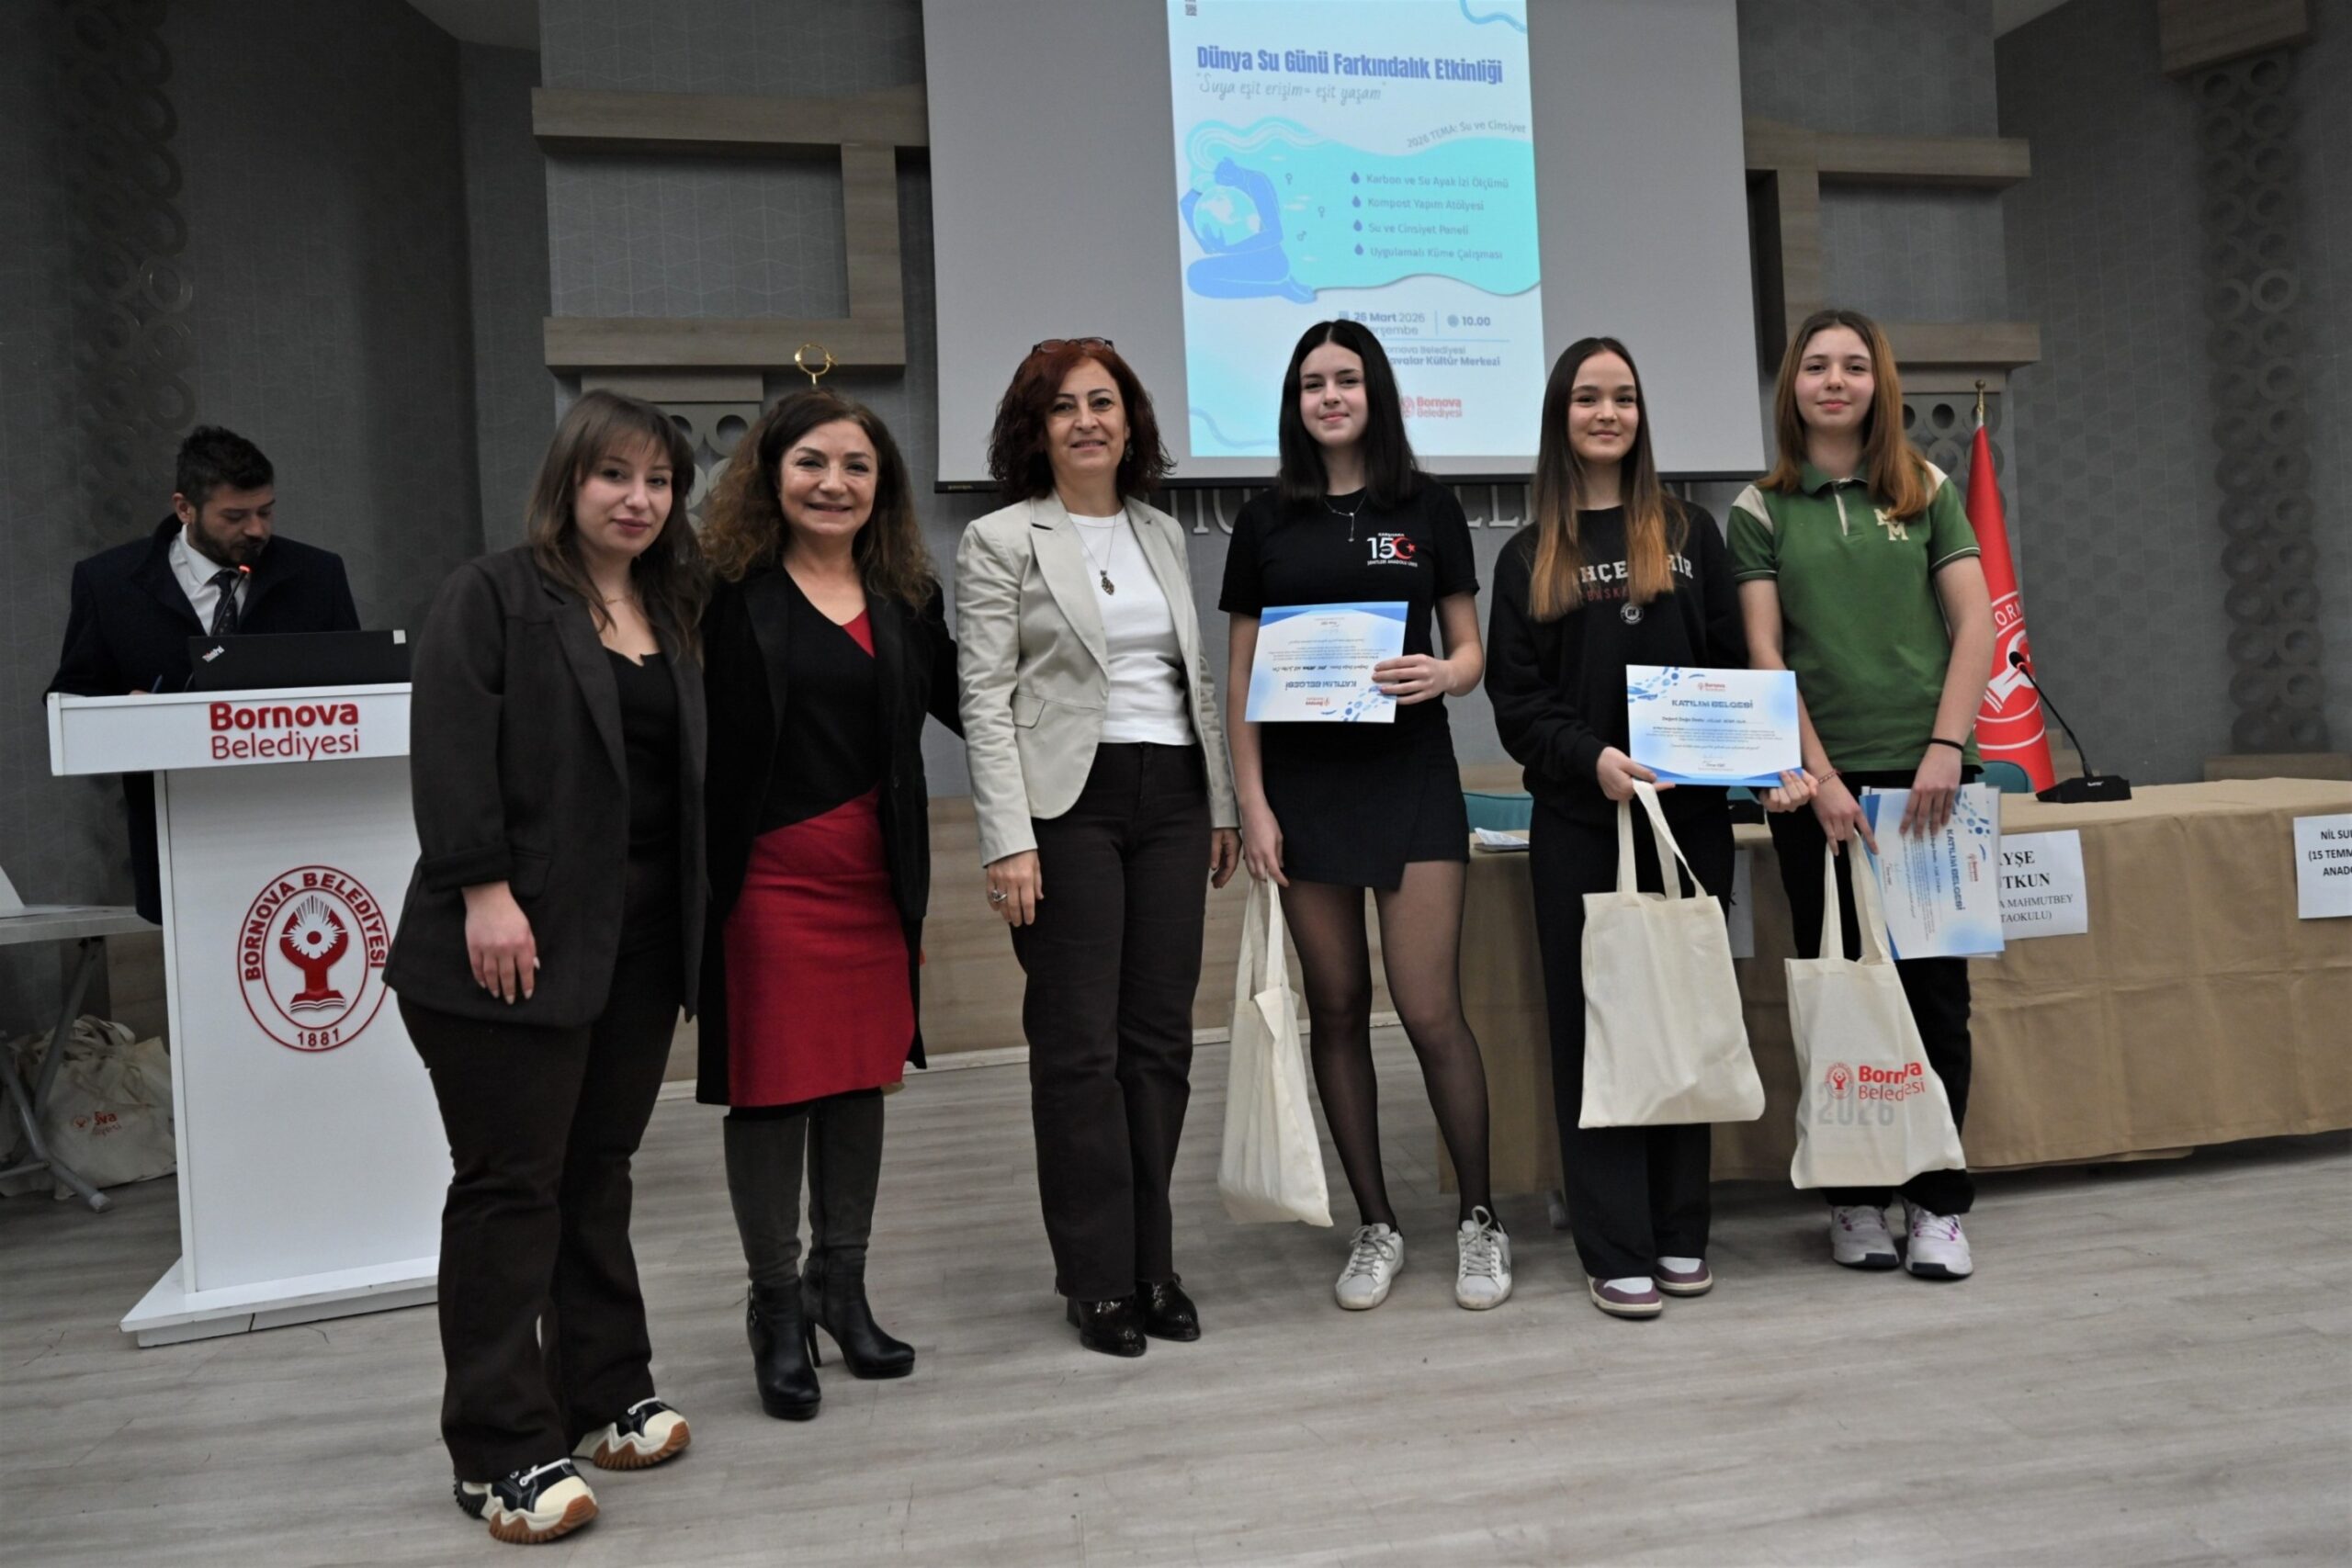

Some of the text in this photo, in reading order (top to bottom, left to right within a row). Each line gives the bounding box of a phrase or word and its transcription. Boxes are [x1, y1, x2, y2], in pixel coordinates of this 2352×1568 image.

[1197, 45, 1503, 85] Dünya Su Günü Farkındalık Etkinliği
[1459, 121, 1473, 132] Su
[1475, 121, 1486, 130] ve
[1487, 119, 1526, 134] Cinsiyet
[1366, 174, 1402, 186] Karbon
[1404, 177, 1416, 186] ve
[1418, 175, 1430, 186] Su
[1433, 176, 1456, 187] Ayak
[1472, 175, 1510, 190] Ölçümü
[1368, 197, 1485, 212] Kompost Yapım Atölyesi
[1368, 222, 1469, 236] Su ve Cinsiyet Paneli
[1370, 247, 1503, 262] Uygulamalı Küme Çalışması
[1369, 312, 1397, 322] Mart
[1398, 312, 1426, 323] 2026
[1462, 316, 1491, 326] 10.00
[1385, 345, 1419, 355] ornova
[1425, 355, 1458, 366] Kültür
[1460, 355, 1501, 367] Merkezi
[1416, 396, 1462, 408] Bornova
[1416, 407, 1463, 420] Belediyesi
[209, 702, 359, 731] Bornova
[210, 728, 359, 761] Belediyesi
[2321, 829, 2335, 840] NİL
[1999, 851, 2035, 867] YŞE
[2308, 850, 2323, 862] (15
[2323, 865, 2352, 876] ANAD
[2007, 894, 2074, 908] MAHMUTBEY
[243, 880, 296, 982] BORNOVA
[297, 1028, 340, 1047] 1881
